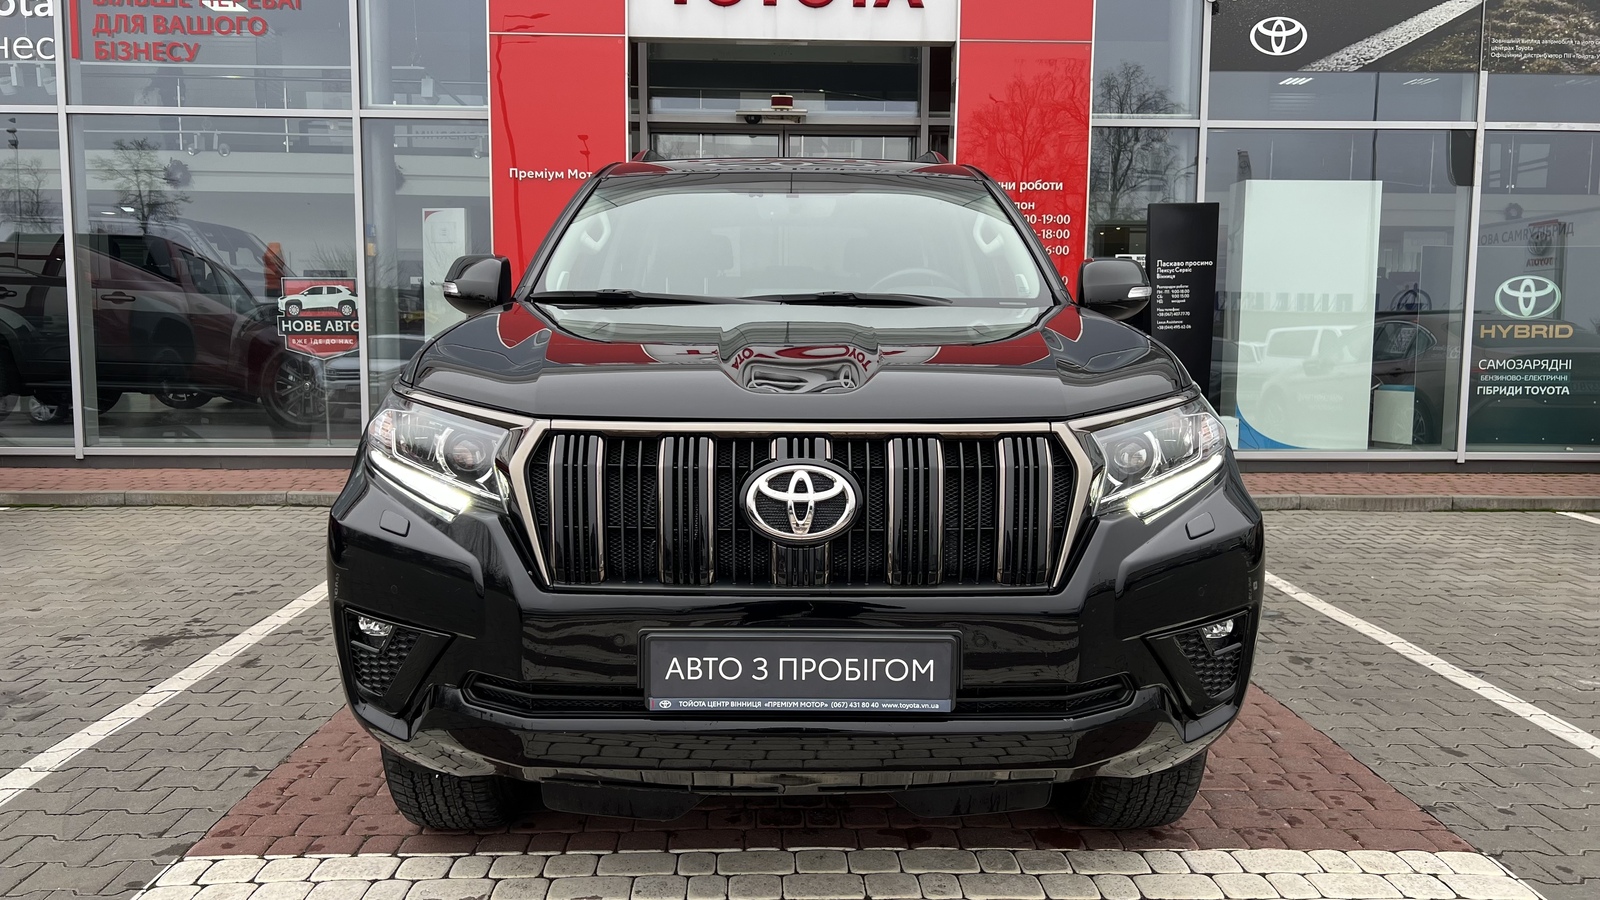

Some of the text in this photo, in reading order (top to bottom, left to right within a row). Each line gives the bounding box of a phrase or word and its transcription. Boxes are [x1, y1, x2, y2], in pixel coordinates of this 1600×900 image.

[92, 14, 268, 36] ДЛЯ ВАШОГО
[94, 41, 200, 62] БІЗНЕСУ
[509, 168, 593, 181] Преміум Мот
[1019, 179, 1063, 193] роботи
[1014, 201, 1035, 210] лон
[1033, 229, 1070, 239] -18:00
[1478, 233, 1499, 246] ОВА
[1501, 227, 1535, 243] CAMRY
[1044, 245, 1070, 255] 6:00
[281, 320, 360, 332] НОВЕ АВТО
[1480, 324, 1574, 339] HYBRID
[1478, 359, 1572, 371] САМОЗАРЯДНІ
[1480, 374, 1568, 382] БЕНЗИНОВО-ЕЛЕКТРИЧНІ
[1477, 386, 1522, 396] ГІБРИДИ
[1524, 386, 1570, 395] TOYOTA
[665, 657, 935, 682] АВТО З ПРОБІГОМ
[831, 701, 848, 709] (067)
[882, 702, 939, 710] www.toyota.vn.ua
